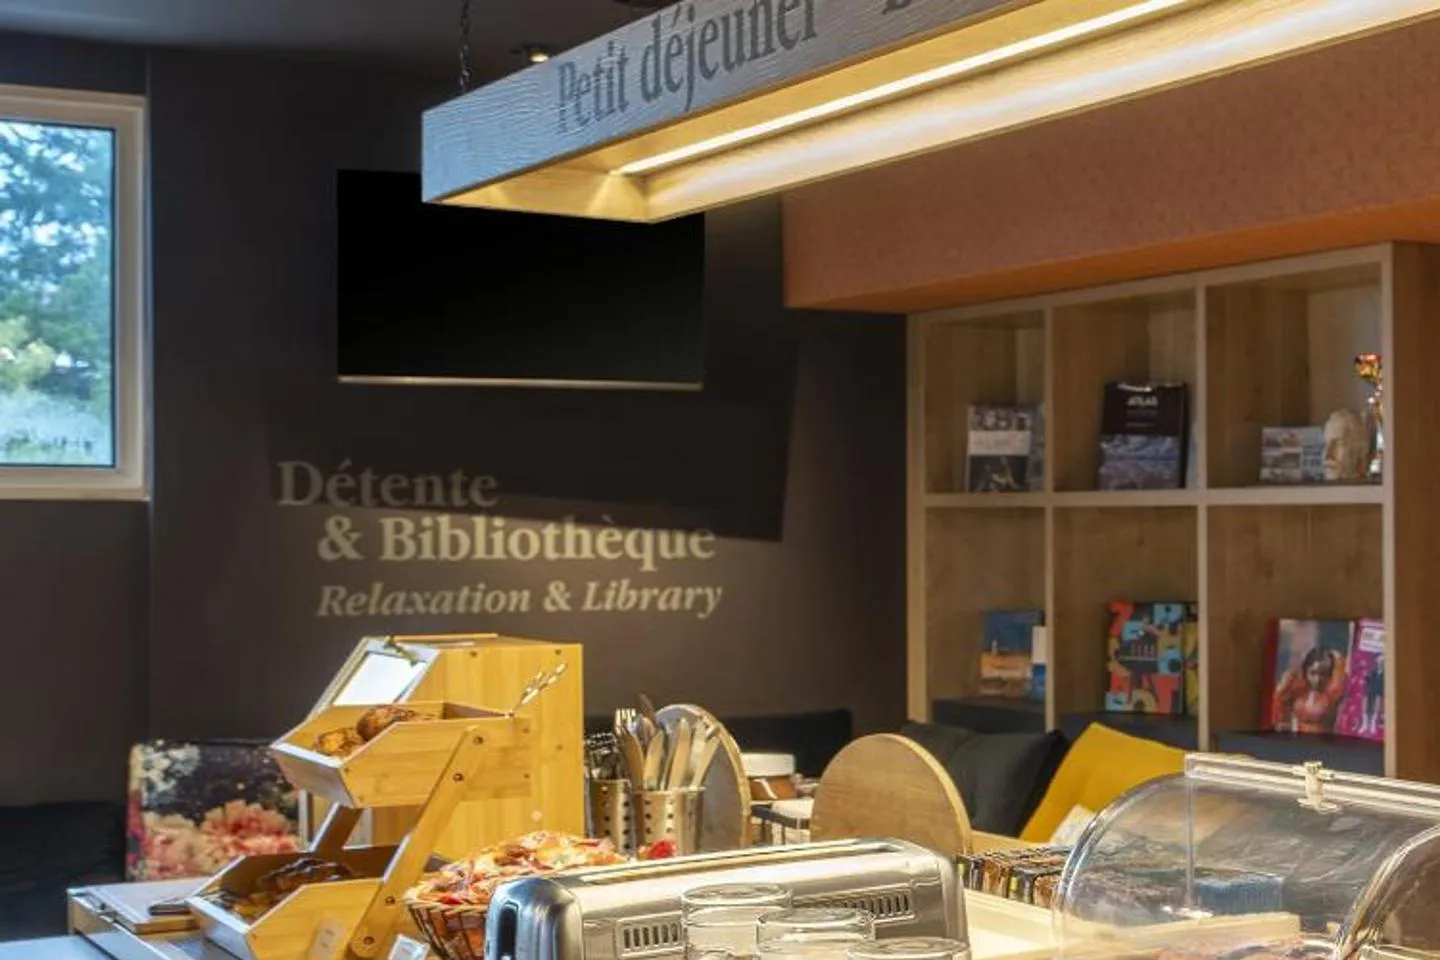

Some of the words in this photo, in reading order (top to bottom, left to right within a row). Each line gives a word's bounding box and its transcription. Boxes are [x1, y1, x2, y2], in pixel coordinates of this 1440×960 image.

[557, 39, 631, 134] Petit
[276, 457, 499, 508] Détente
[316, 515, 364, 561] &
[379, 514, 717, 571] Bibliothèque
[315, 582, 531, 617] Relaxation
[542, 581, 573, 611] &
[581, 578, 722, 618] Library
